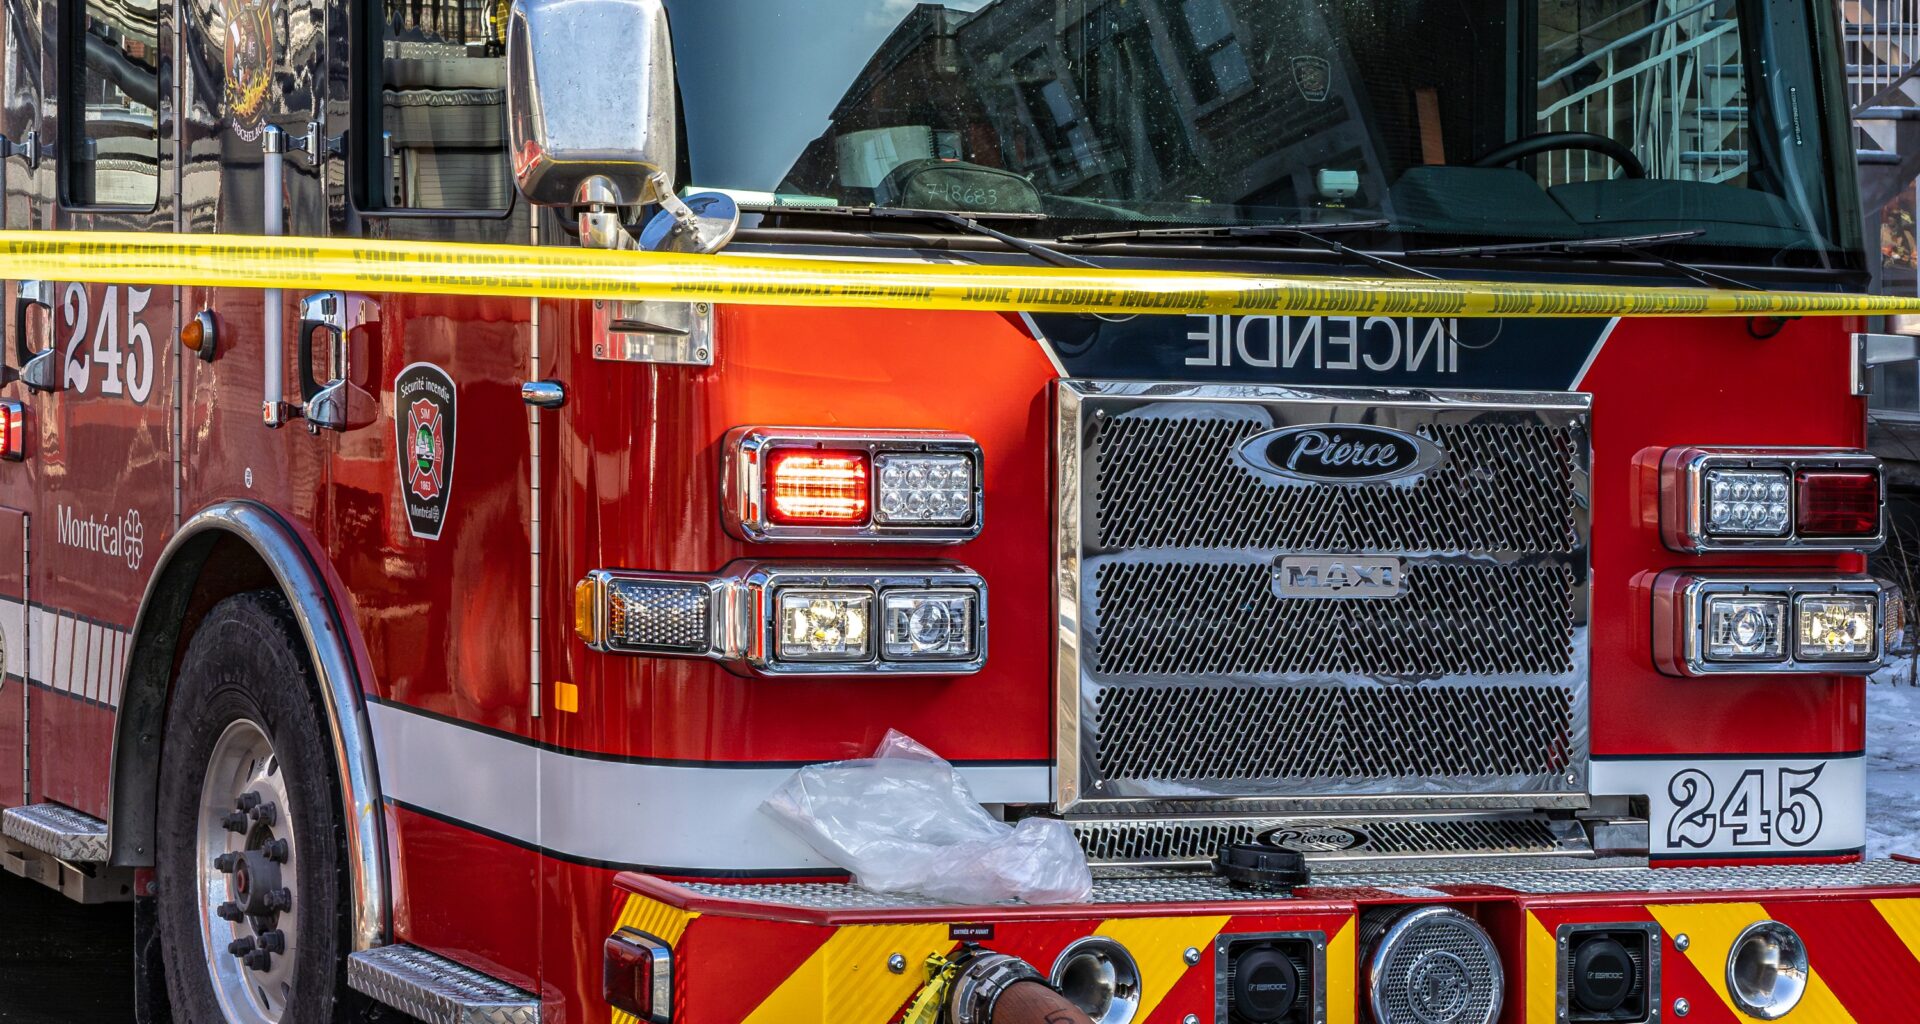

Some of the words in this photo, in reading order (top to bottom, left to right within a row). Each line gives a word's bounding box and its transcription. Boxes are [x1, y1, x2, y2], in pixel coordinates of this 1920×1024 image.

[232, 117, 267, 142] HOCHELAGA
[63, 281, 154, 403] 245
[401, 376, 425, 399] Sécurité
[425, 376, 450, 404] incendie
[420, 407, 431, 419] SIM
[1286, 430, 1399, 471] Pierce
[411, 503, 433, 519] Montréal
[57, 504, 122, 557] Montréal
[1286, 561, 1395, 589] MAXI
[1666, 761, 1827, 848] 245
[1278, 830, 1349, 846] Pierce
